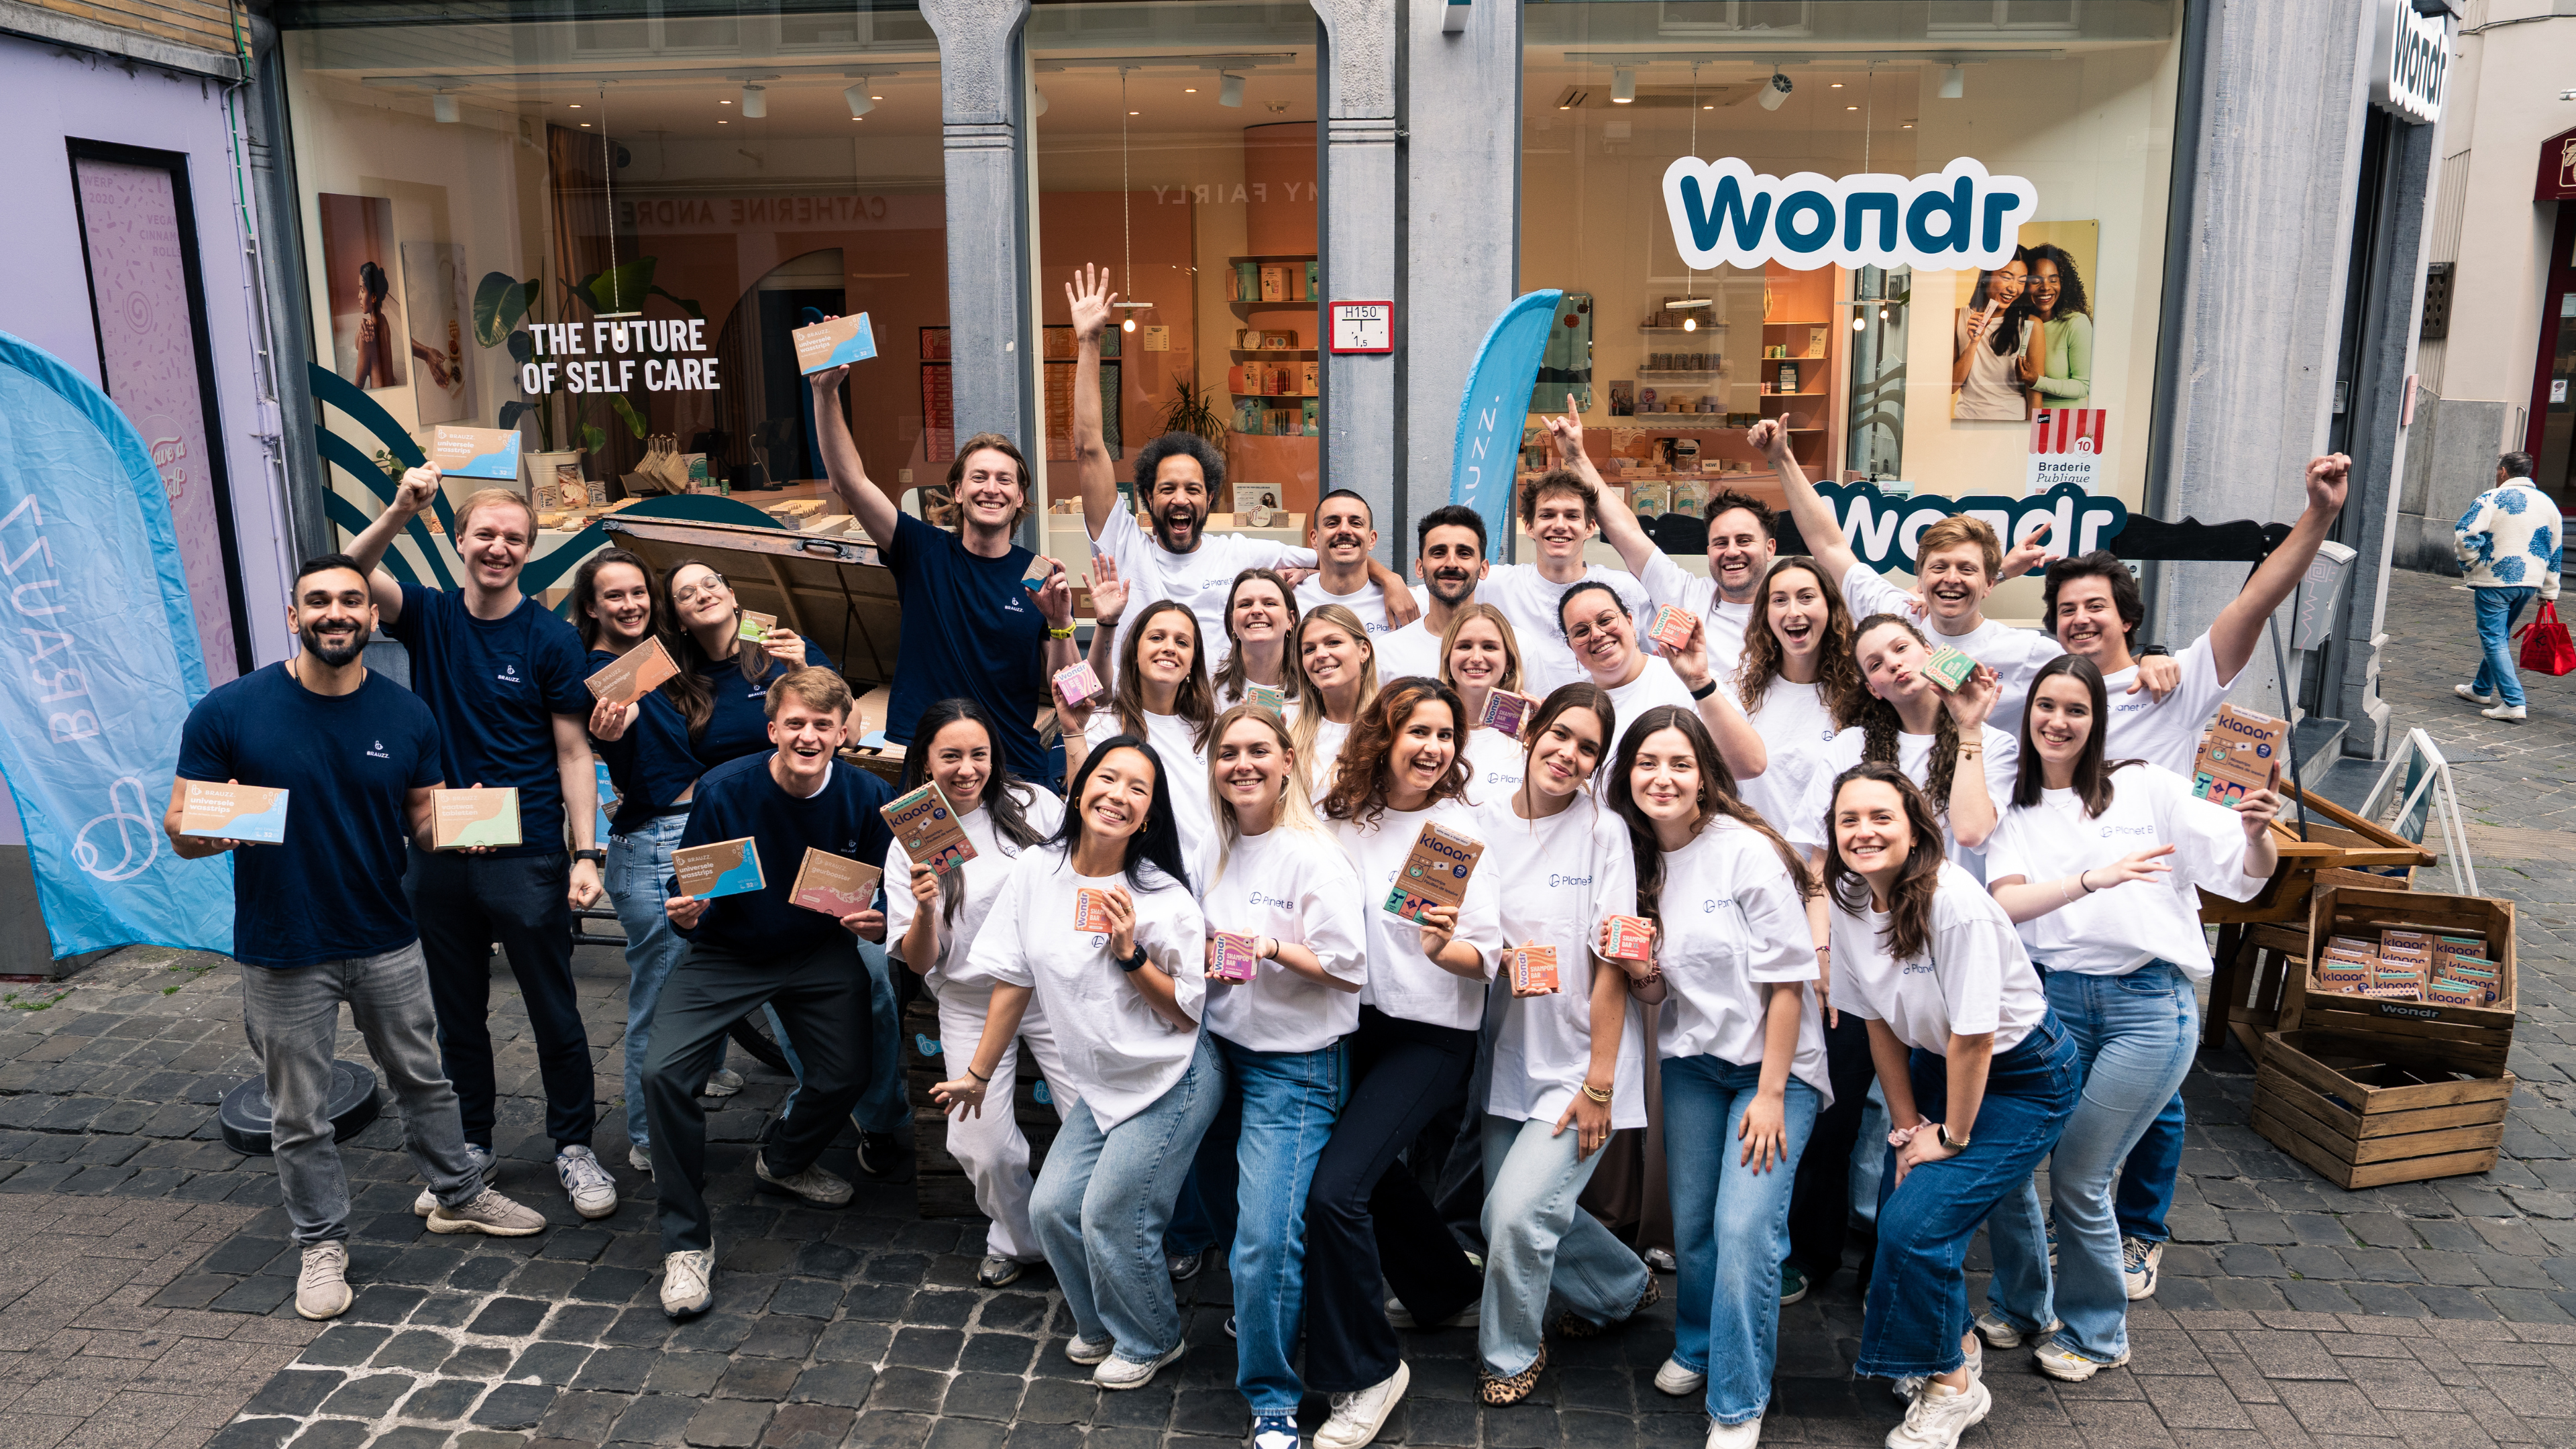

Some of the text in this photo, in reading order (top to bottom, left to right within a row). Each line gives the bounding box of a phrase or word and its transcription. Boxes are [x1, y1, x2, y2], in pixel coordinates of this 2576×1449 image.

[2394, 1, 2446, 107] Wondr
[1680, 176, 2020, 254] Wondr
[140, 229, 179, 241] CINNAM
[152, 246, 181, 258] ROLLS
[1346, 306, 1377, 317] H150
[529, 319, 706, 355] THE FUTURE
[807, 329, 830, 338] BRAUZZ.
[799, 335, 831, 347] universele
[1354, 335, 1367, 347] 1,5
[800, 342, 830, 354] wasstrips
[523, 357, 720, 394] OF SELF CARE
[2078, 441, 2091, 451] 10
[2039, 462, 2090, 472] Braderie
[2036, 473, 2090, 483] Publique
[1653, 608, 1670, 635] Wondr
[1666, 623, 1688, 635] SHAMPOO
[1059, 664, 1085, 681] Wondr
[1944, 661, 1955, 672] BODY
[1949, 662, 1962, 676] SCRUB
[598, 671, 631, 694] toiletreiniger
[1927, 667, 1956, 688] Wondr
[1073, 677, 1085, 695] SHAMPOO
[1485, 696, 1500, 723] Wondr
[1499, 710, 1519, 719] SHAMPOO
[2218, 714, 2273, 741] klaaar
[1501, 774, 1523, 784] Plane
[191, 797, 235, 806] universele
[190, 804, 230, 814] wasstrips
[889, 799, 936, 828] klaaar
[2147, 825, 2153, 834] B
[1419, 833, 1471, 862] klaaar
[688, 855, 712, 863] BRAUZZ.
[679, 863, 714, 873] universele
[681, 869, 713, 879] wasstrips
[812, 867, 851, 881] geurbooster
[1426, 875, 1446, 886] Wasstrips
[1562, 876, 1587, 885] Plane
[1424, 879, 1439, 889] Feuilles
[1445, 888, 1458, 897] lessive
[1078, 893, 1087, 926] Wondr
[1287, 901, 1293, 909] B
[1610, 920, 1620, 953] Wondr
[1622, 935, 1646, 943] SHAMPOO
[1215, 936, 1224, 970] Wondr
[2436, 943, 2480, 956] klaaar
[1226, 953, 1249, 963] SHAMPOO
[1519, 953, 1527, 986] Wondr
[1912, 963, 1933, 973] Plane
[2323, 973, 2366, 981] klaaar
[2427, 991, 2470, 1004] klaaar
[2381, 1004, 2438, 1018] Wondr
